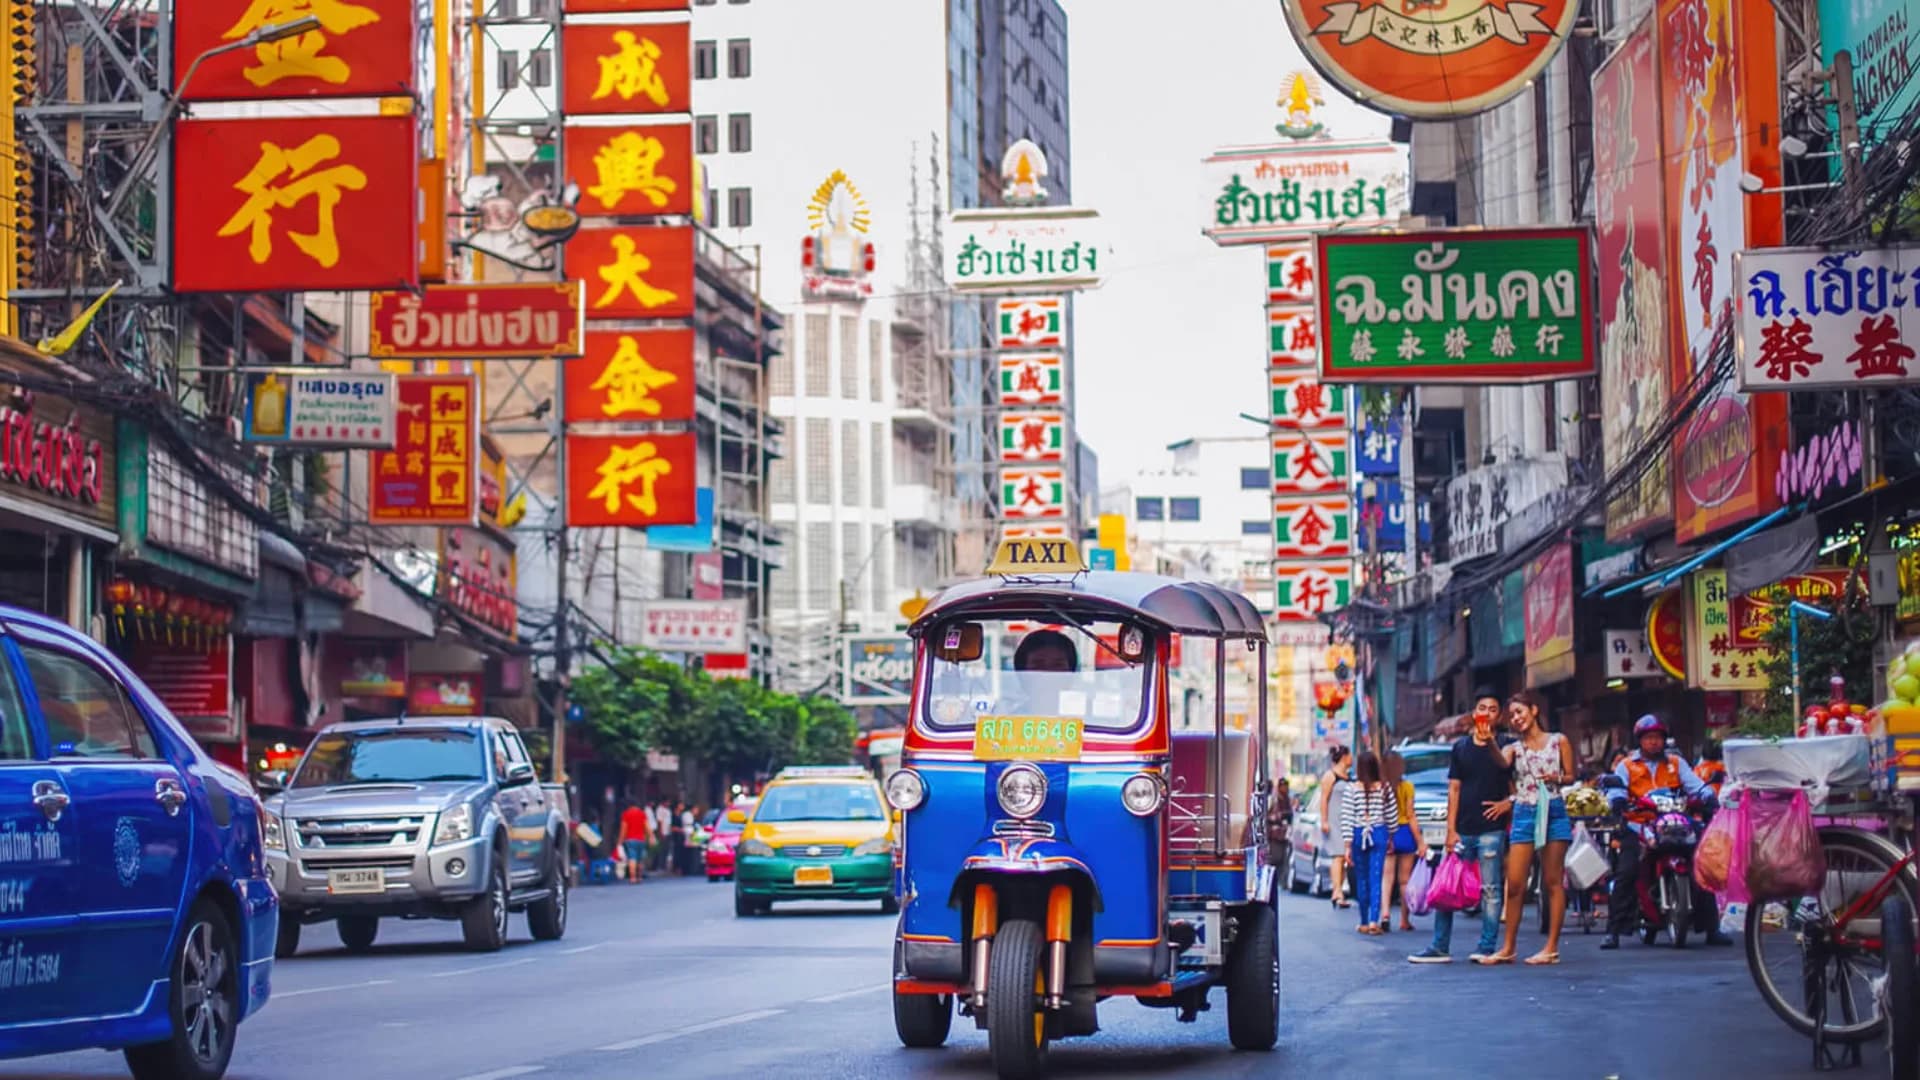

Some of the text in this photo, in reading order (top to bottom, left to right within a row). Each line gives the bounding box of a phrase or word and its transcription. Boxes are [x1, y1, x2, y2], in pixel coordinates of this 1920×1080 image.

[1856, 2, 1908, 66] YAOWARAJ
[1856, 35, 1911, 118] NGKOK
[1335, 242, 1576, 324] ฉ.มั่นคง
[1017, 309, 1047, 536] 和成興大
[1007, 542, 1067, 564] TAXI
[1023, 720, 1077, 741] 6646
